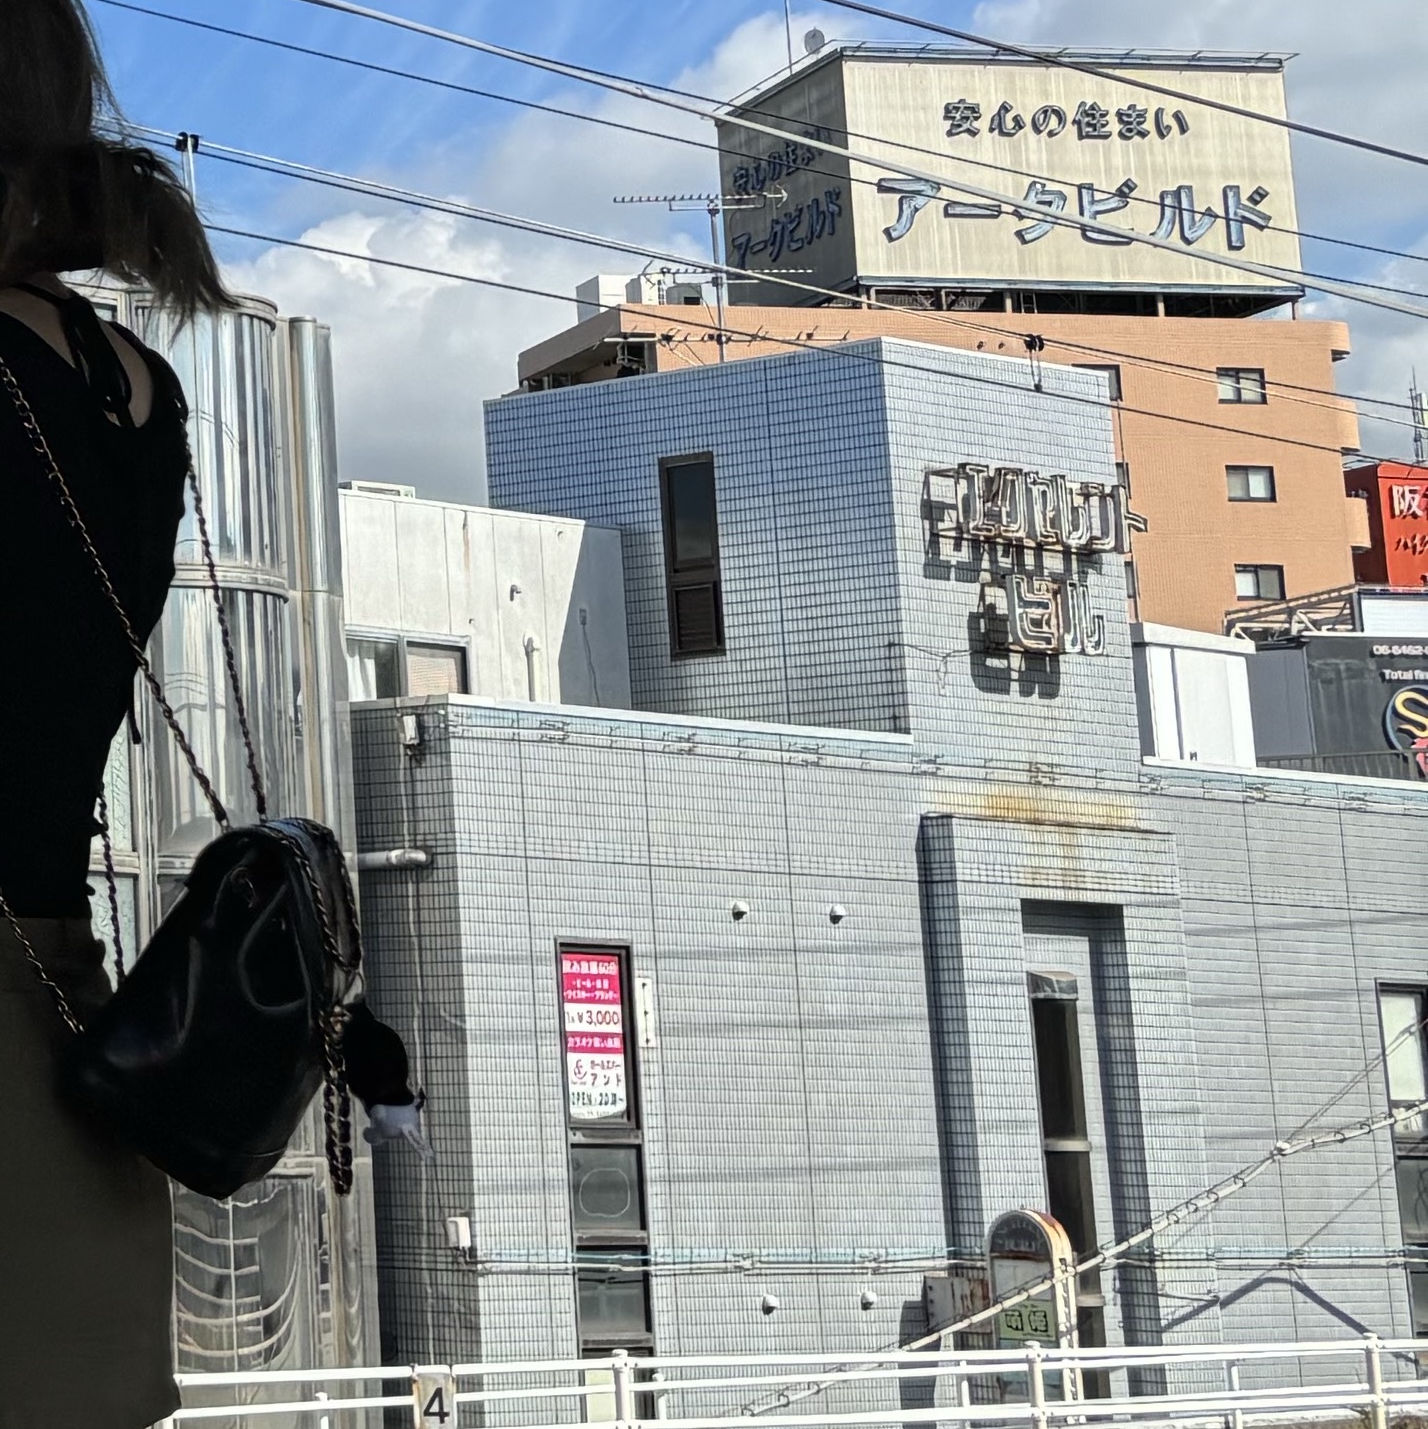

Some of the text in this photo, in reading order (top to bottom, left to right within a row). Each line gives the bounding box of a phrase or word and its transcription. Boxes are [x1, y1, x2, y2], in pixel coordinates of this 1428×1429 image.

[943, 98, 1190, 141] 安心の住まい
[877, 178, 1272, 250] アークビルド
[1392, 484, 1428, 517] 阪
[1382, 668, 1413, 681] Total
[422, 1386, 451, 1425] 4
